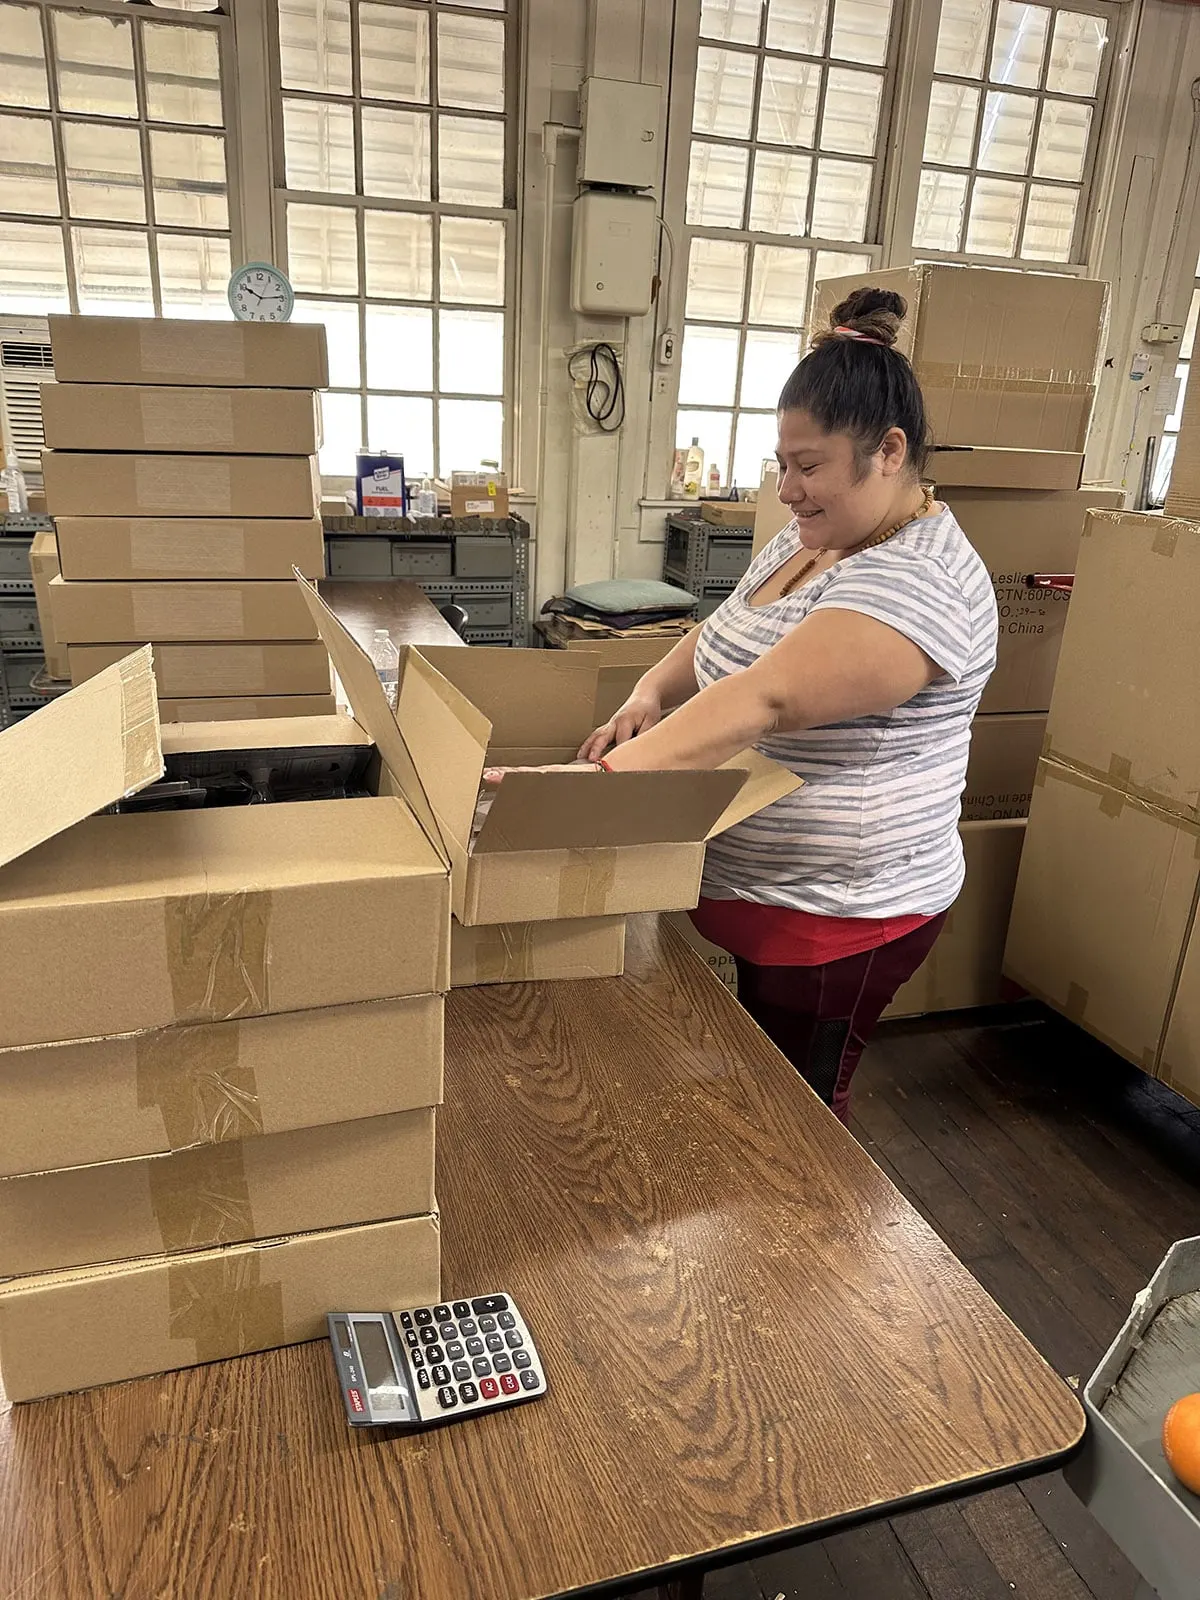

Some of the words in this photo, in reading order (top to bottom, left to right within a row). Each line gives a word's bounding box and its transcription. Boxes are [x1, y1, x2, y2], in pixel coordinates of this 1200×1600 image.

[256, 272, 264, 281] 12
[237, 293, 243, 301] 9
[241, 304, 247, 312] 8
[270, 312, 275, 320] 5
[991, 572, 1027, 584] Leslie
[1008, 622, 1044, 634] China
[998, 793, 1009, 803] in
[1012, 793, 1032, 804] ade
[708, 955, 735, 968] ade
[436, 1366, 447, 1380] MRC
[464, 1385, 474, 1397] MU
[485, 1381, 494, 1392] AC
[350, 1389, 364, 1412] STAPLES
